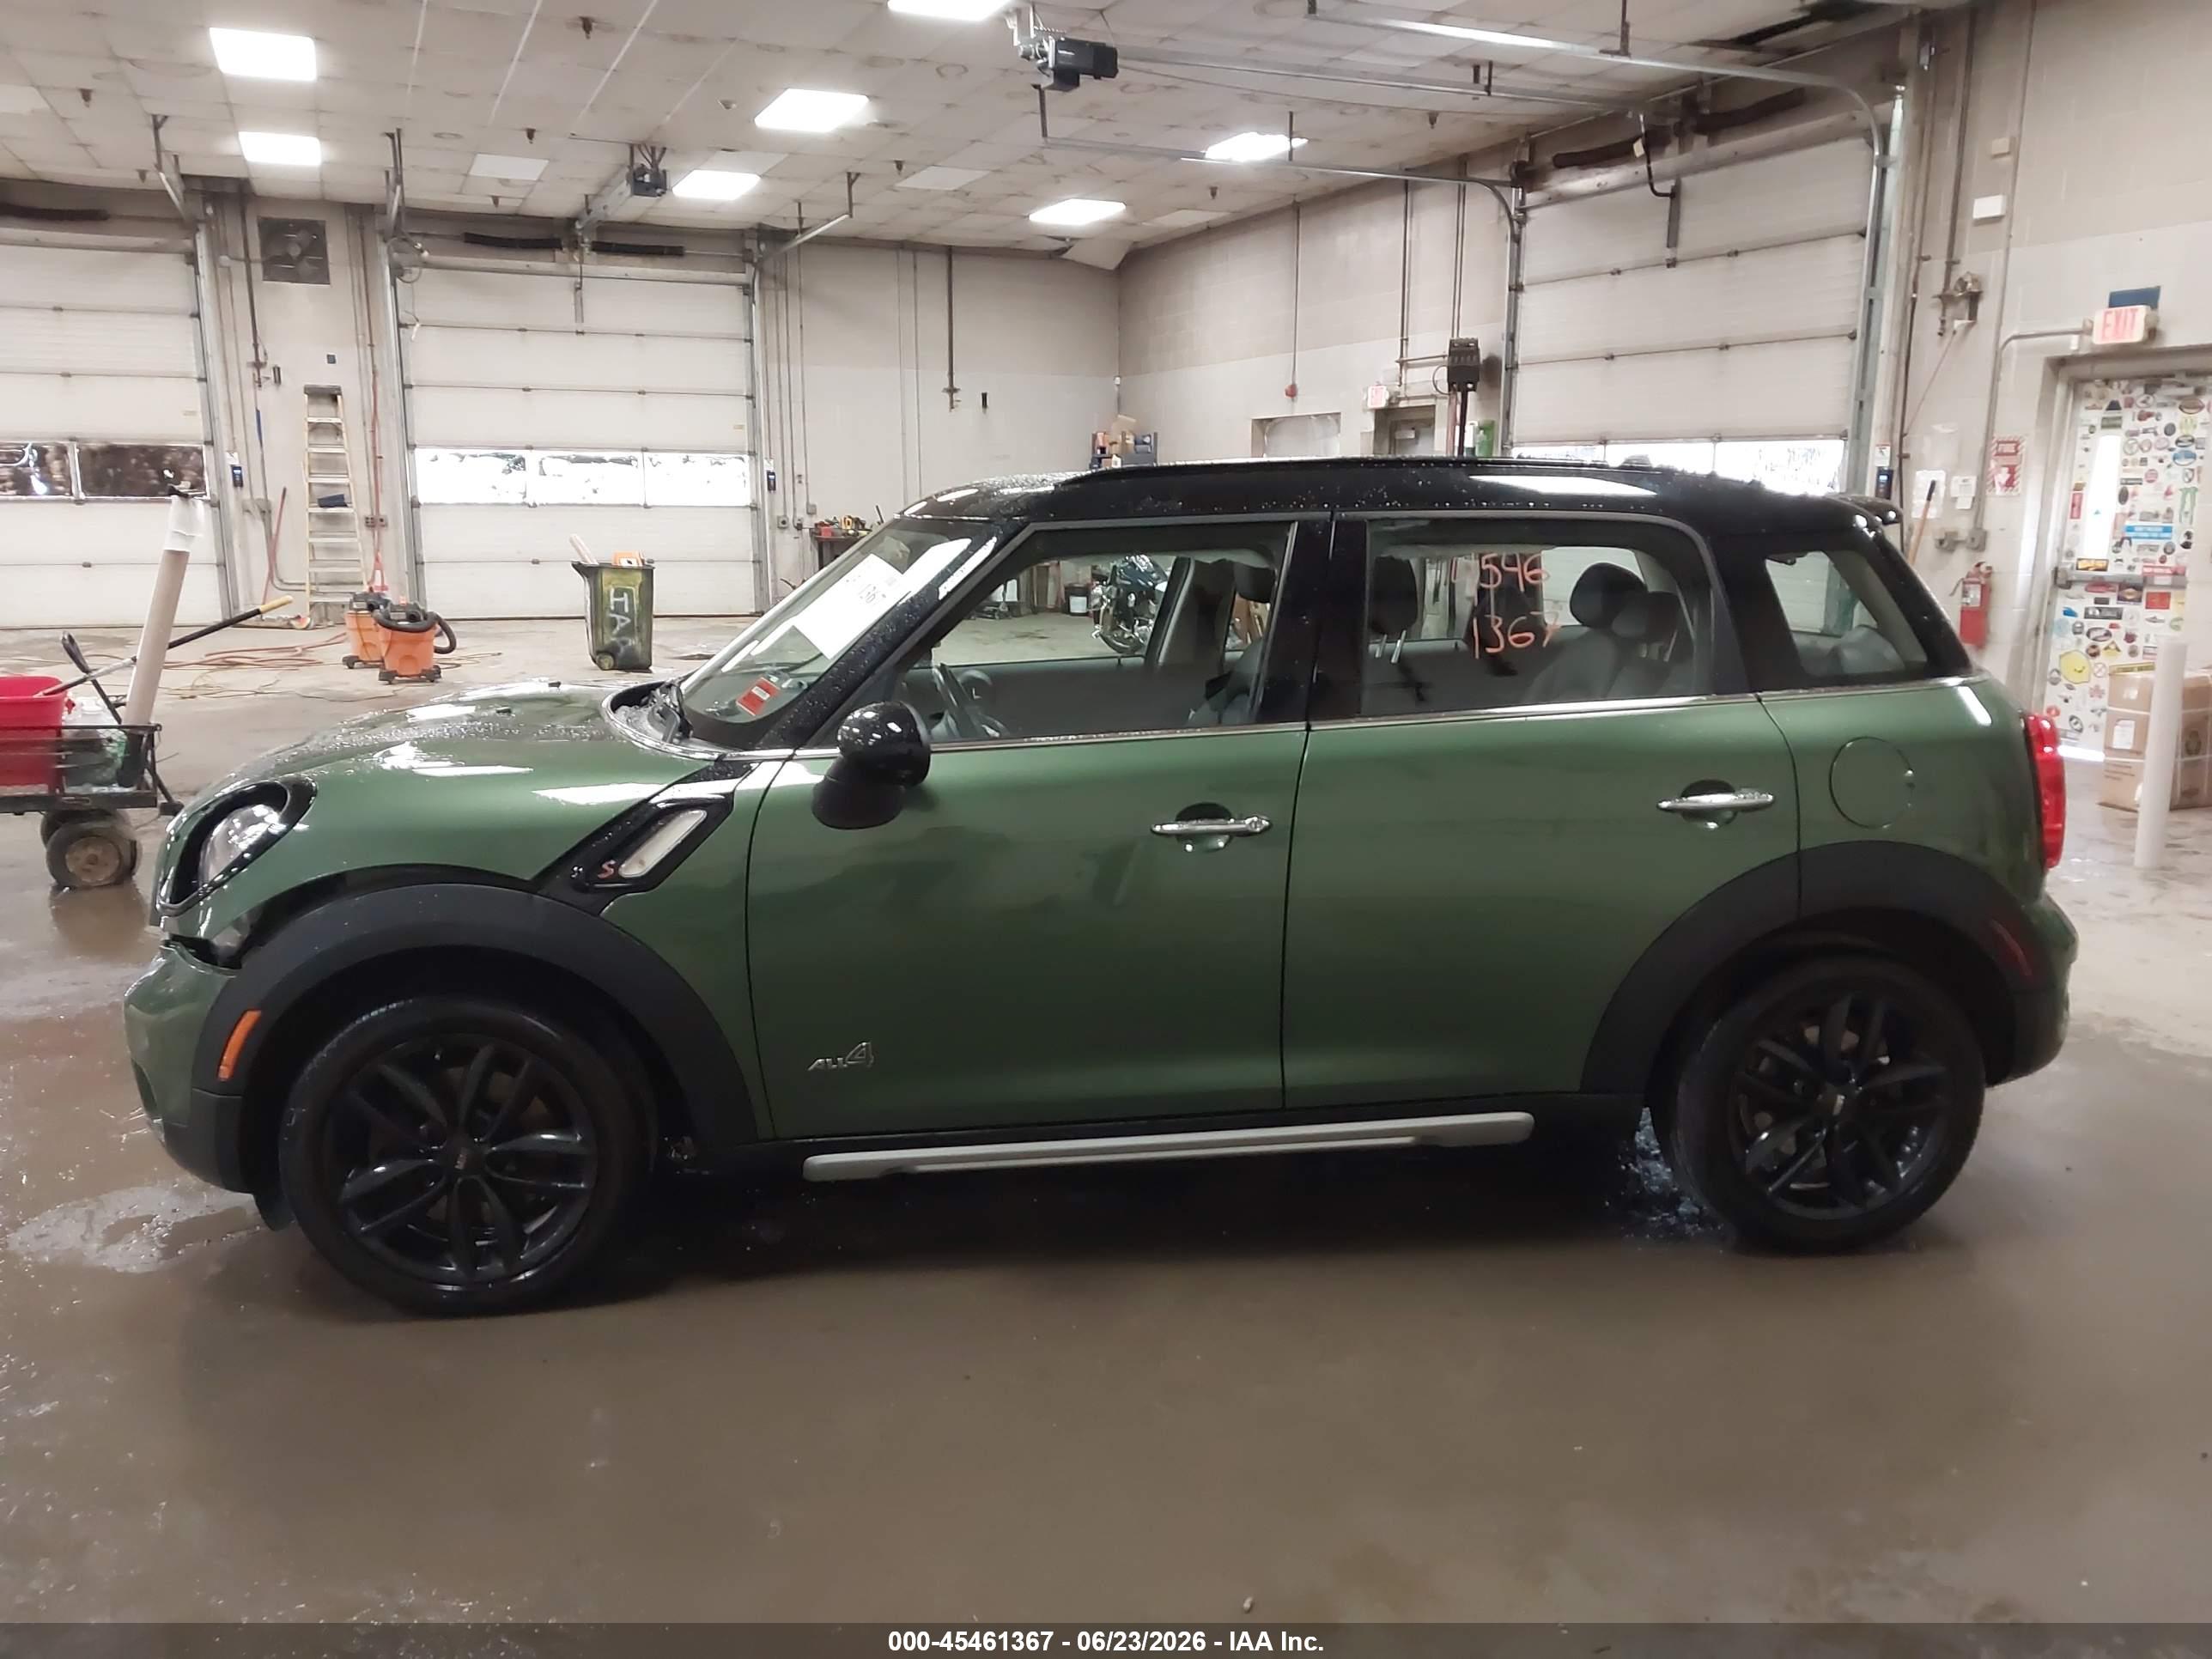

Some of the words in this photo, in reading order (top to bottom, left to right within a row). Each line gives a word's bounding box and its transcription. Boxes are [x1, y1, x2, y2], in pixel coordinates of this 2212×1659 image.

[2101, 307, 2139, 342] EXIT
[1473, 610, 1562, 659] 1367
[597, 860, 617, 879] S
